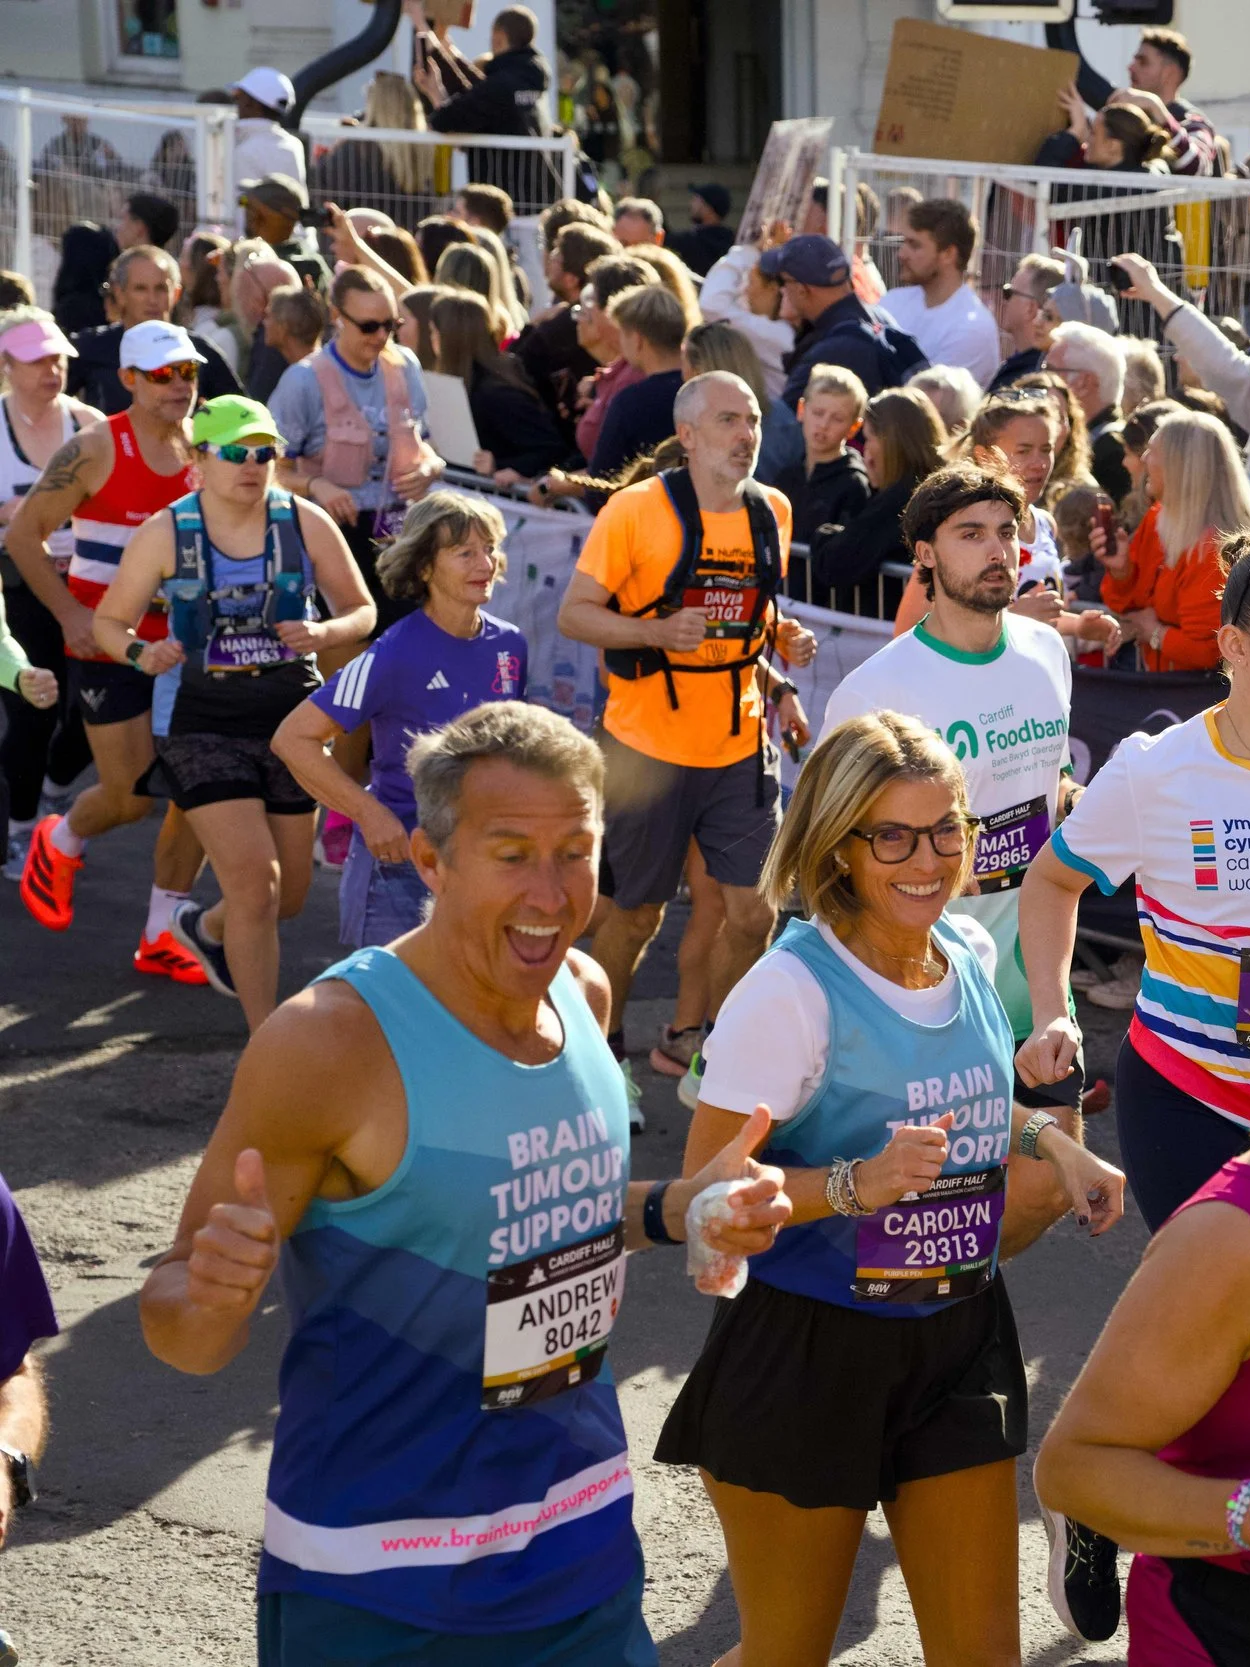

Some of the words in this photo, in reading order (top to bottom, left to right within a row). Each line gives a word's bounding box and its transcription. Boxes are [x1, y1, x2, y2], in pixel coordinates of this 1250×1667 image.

[233, 650, 281, 665] 10463
[978, 704, 1015, 726] Cardiff
[991, 754, 1008, 768] Banc
[1008, 749, 1030, 763] Bwyd
[991, 765, 1022, 782] Together
[989, 809, 1015, 825] CARDIFF
[1014, 803, 1031, 815] HALF
[980, 825, 1026, 854] MATT
[977, 843, 1031, 873] 29865
[906, 1063, 995, 1112] BRAIN
[507, 1106, 609, 1171] BRAIN
[489, 1146, 624, 1220] TUMOUR
[929, 1177, 963, 1191] ARDIFF
[963, 1173, 988, 1187] HALF
[883, 1200, 992, 1237] CAROLYN
[548, 1240, 592, 1270] CARDIFF
[592, 1234, 616, 1254] HALF
[904, 1232, 979, 1266] 29313
[883, 1269, 909, 1277] PURPLE
[909, 1269, 923, 1277] PEN
[518, 1265, 619, 1332] ANDREW
[867, 1282, 891, 1295] R4W
[545, 1309, 602, 1356] 8042
